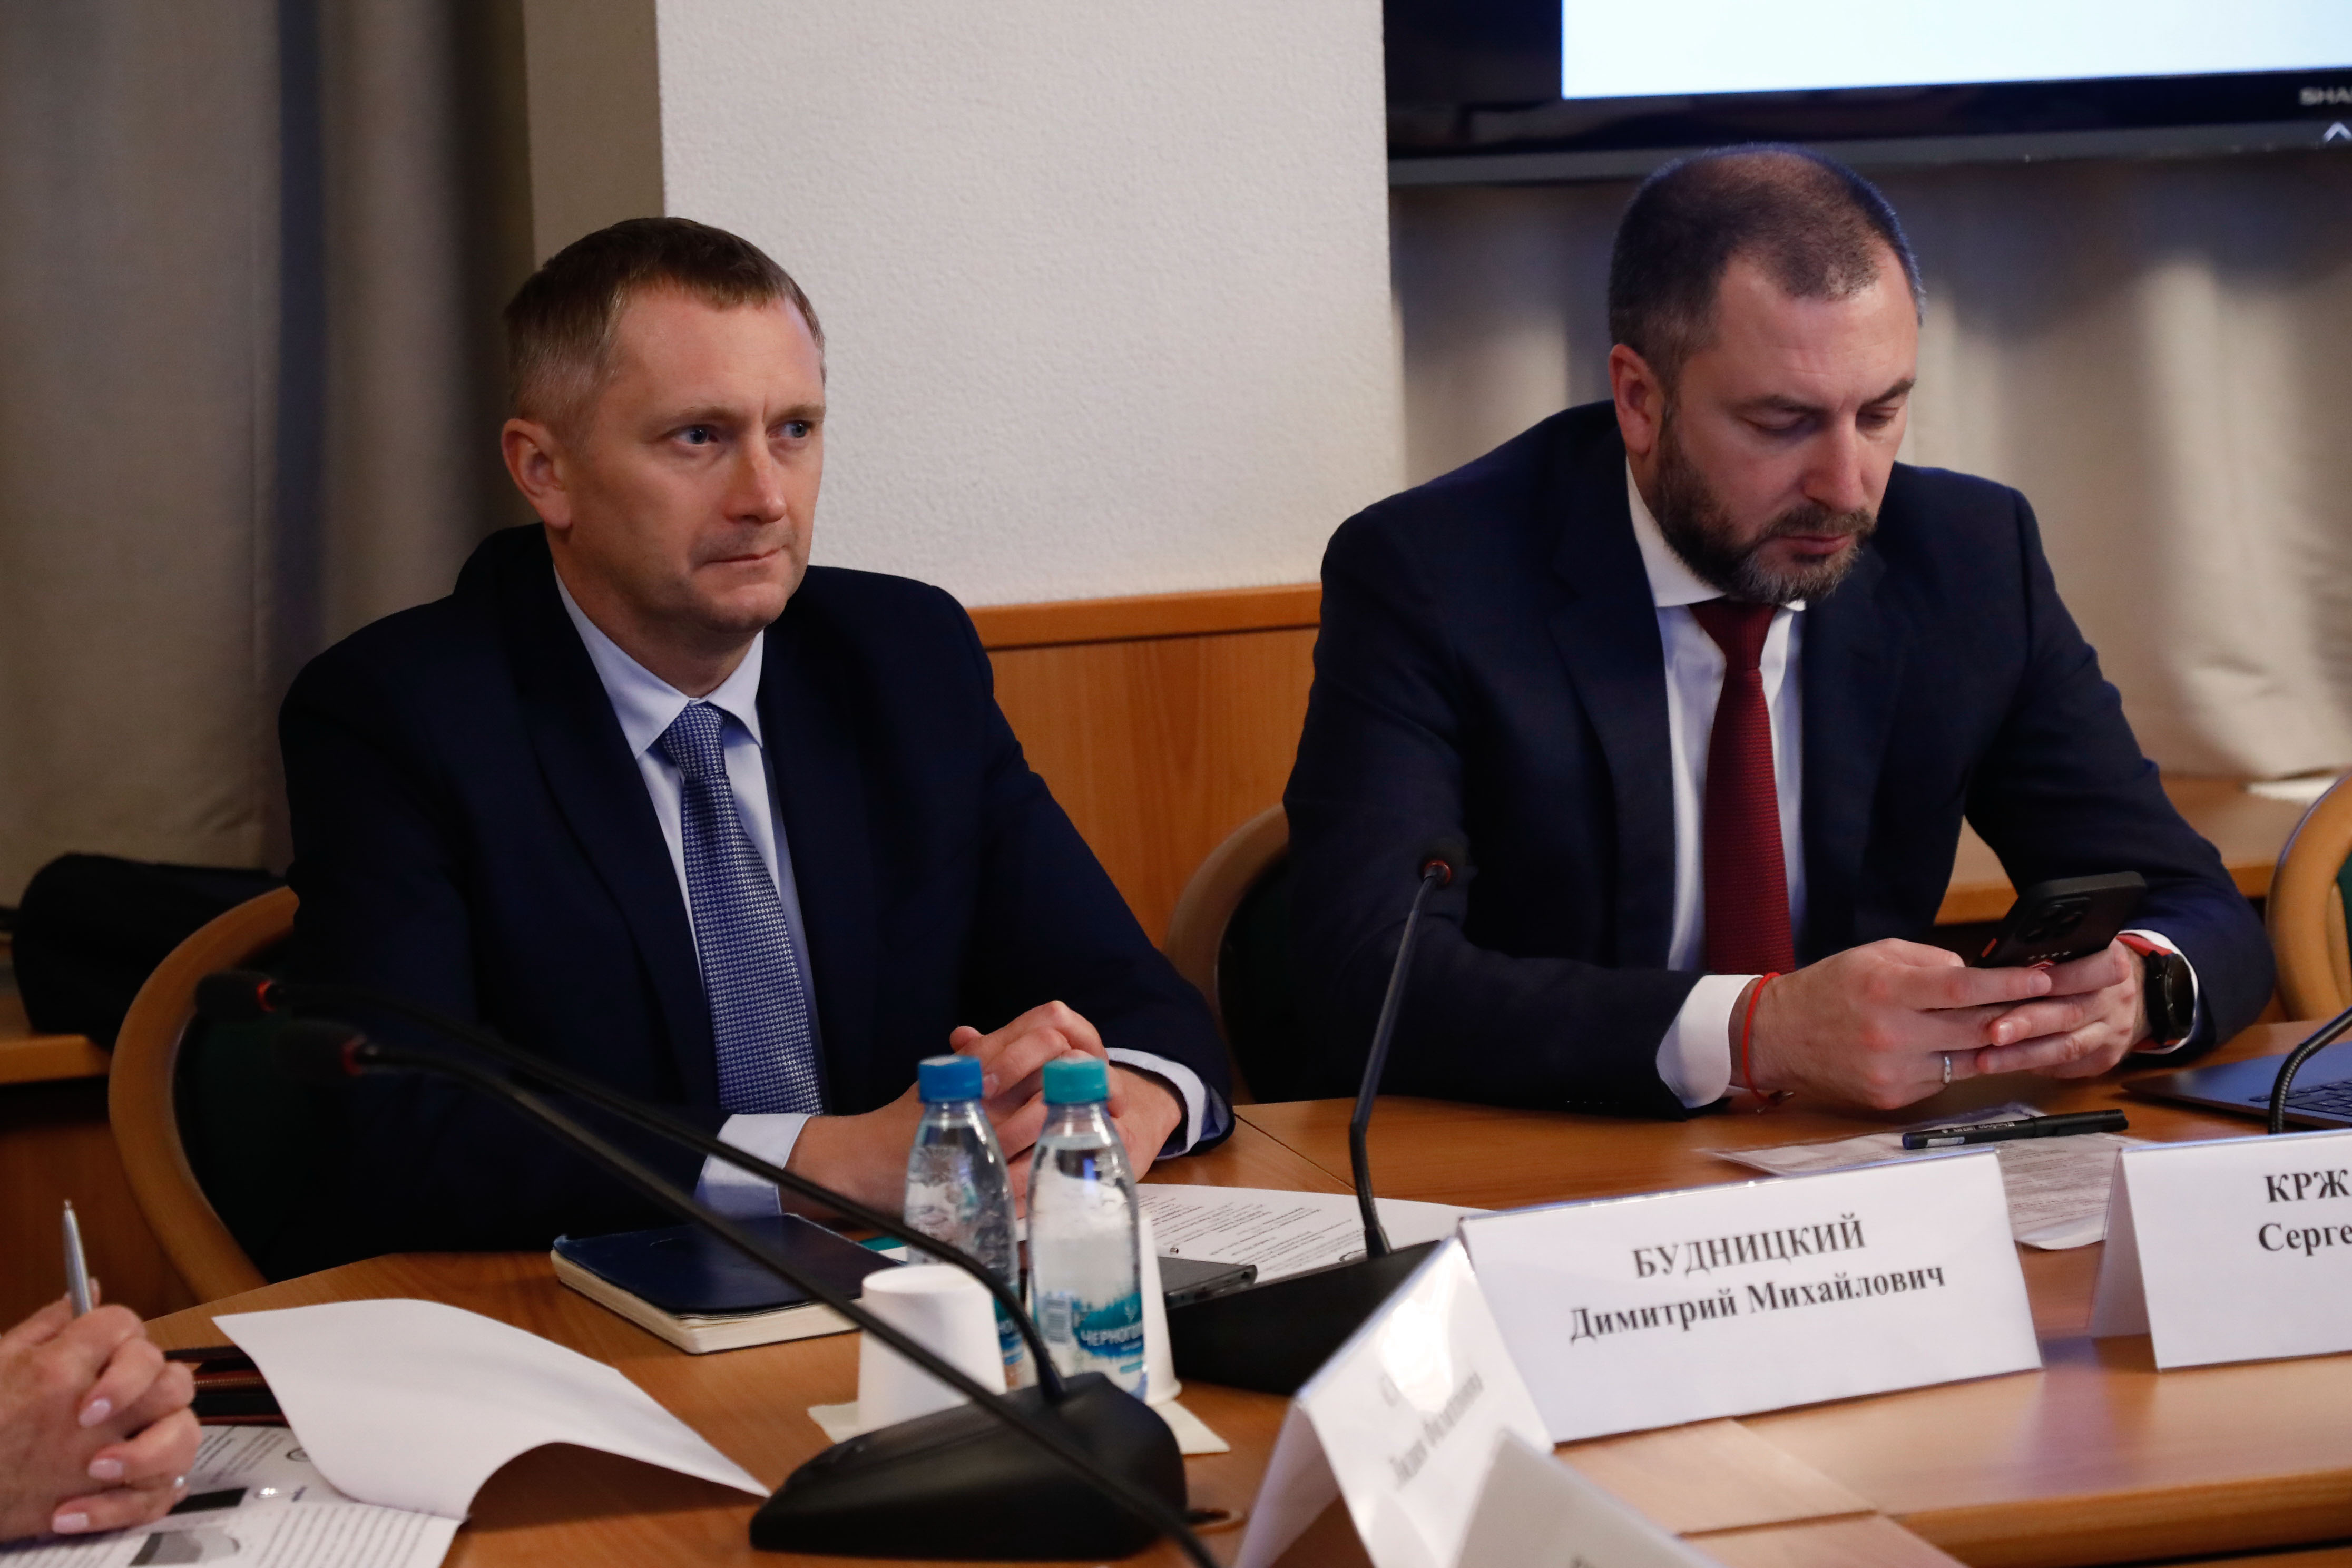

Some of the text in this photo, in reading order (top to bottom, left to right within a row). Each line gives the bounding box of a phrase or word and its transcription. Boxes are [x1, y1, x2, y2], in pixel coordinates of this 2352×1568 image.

[2299, 86, 2352, 106] SHA
[2264, 1169, 2351, 1203] КРЖ
[1632, 1213, 1866, 1278] БУДНИЦКИЙ
[2258, 1222, 2352, 1257] Серге
[1570, 1266, 1946, 1345] Димитрий Михайлович
